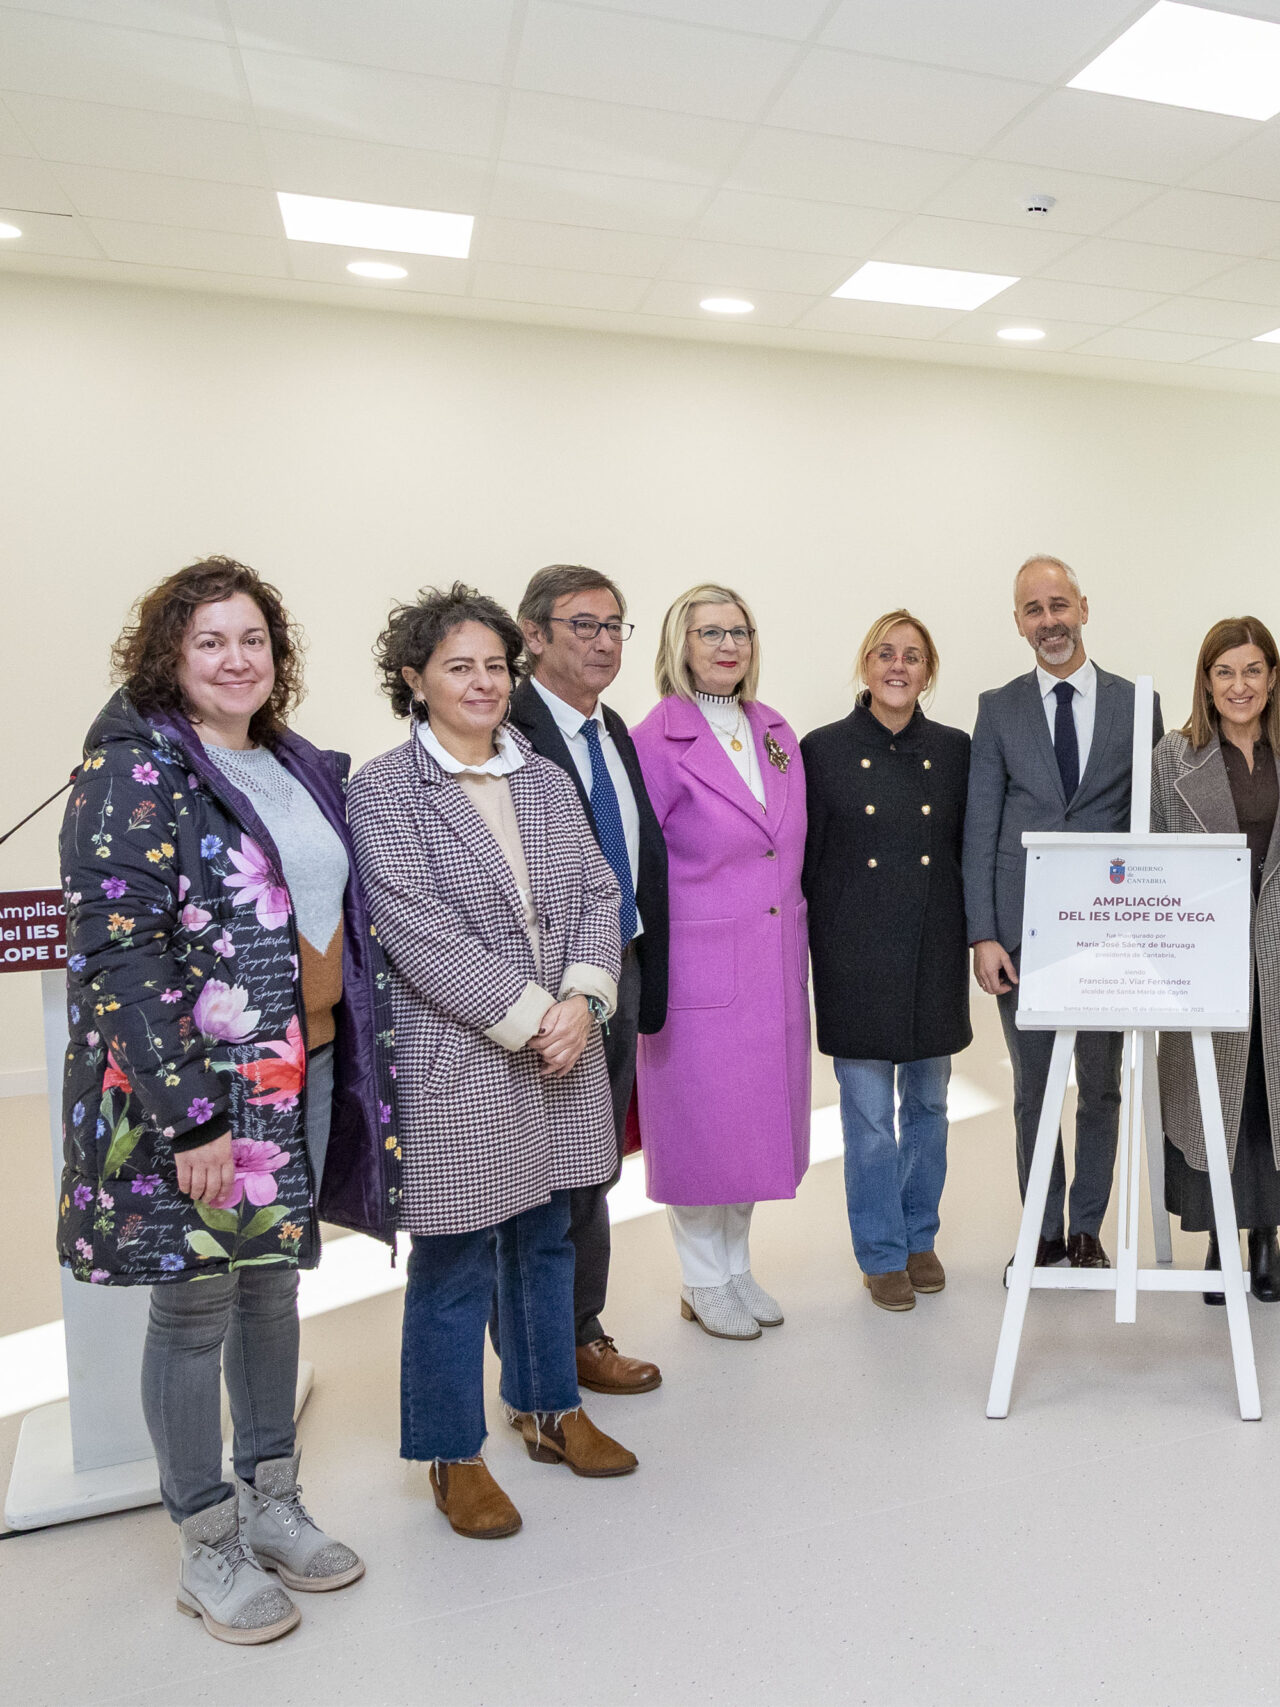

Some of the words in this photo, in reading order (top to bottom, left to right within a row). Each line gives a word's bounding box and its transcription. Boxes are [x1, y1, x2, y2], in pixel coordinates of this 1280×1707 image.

[1092, 895, 1182, 907] AMPLIACIÓN
[0, 902, 67, 920] mpliac
[1058, 911, 1086, 921] DEL
[1089, 911, 1111, 921] IES
[1114, 911, 1150, 922] LOPE
[1154, 912, 1173, 922] DE
[1176, 912, 1216, 922] VEGA
[26, 924, 60, 940] IES
[1076, 940, 1099, 948] María
[1101, 940, 1120, 948] José
[1121, 940, 1146, 949] Sáenz
[1147, 941, 1158, 949] de
[1160, 941, 1196, 950] Buruaga
[55, 944, 67, 959] D
[1078, 977, 1119, 985] Francisco
[1120, 977, 1127, 985] J.
[1129, 977, 1145, 985] Viar
[1147, 977, 1192, 986] Fernández
[1167, 988, 1188, 996] Cayón
